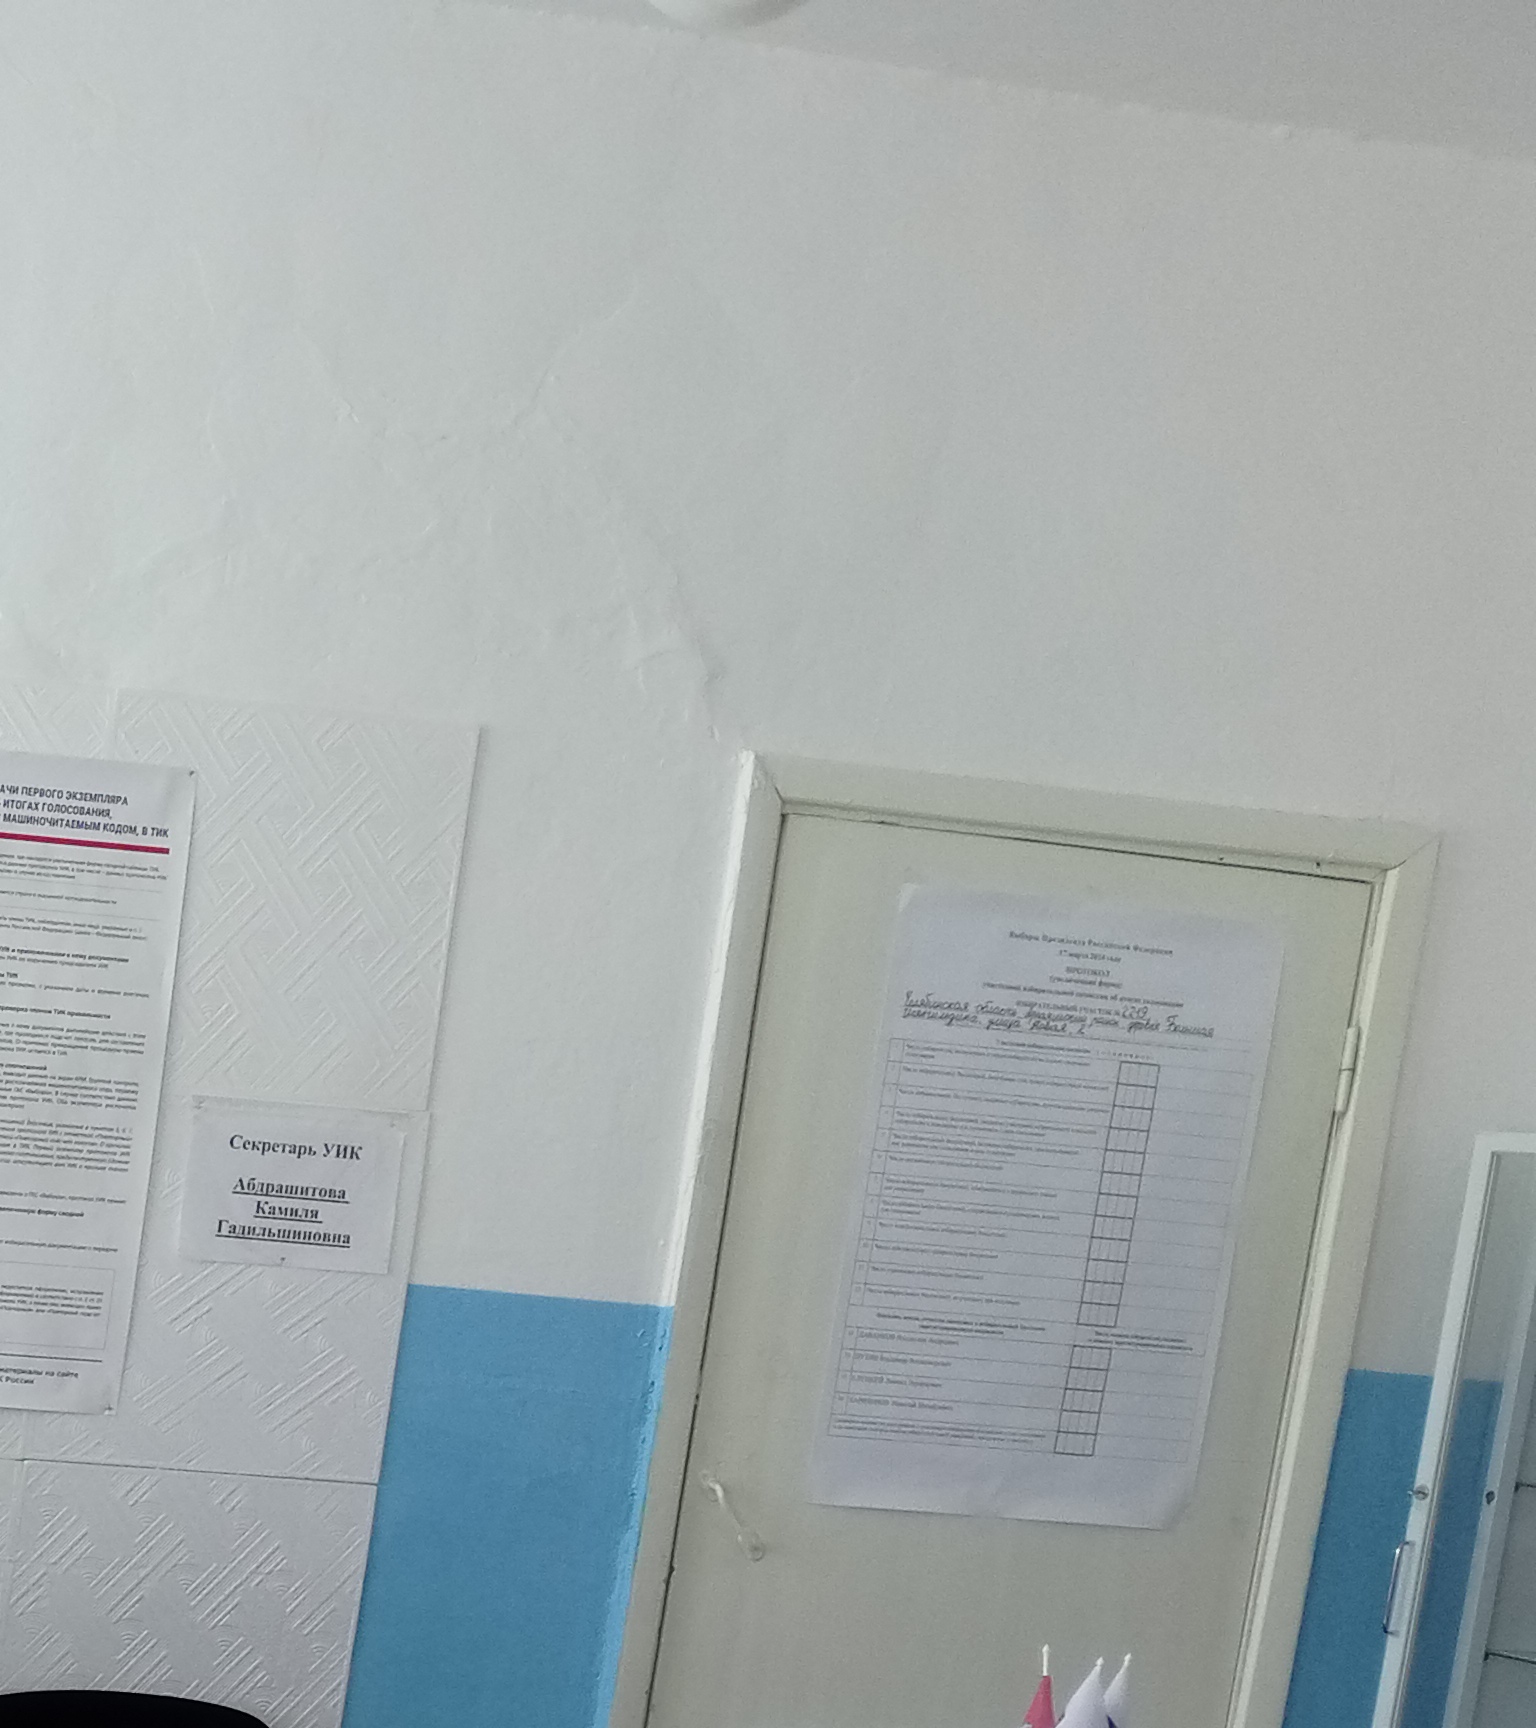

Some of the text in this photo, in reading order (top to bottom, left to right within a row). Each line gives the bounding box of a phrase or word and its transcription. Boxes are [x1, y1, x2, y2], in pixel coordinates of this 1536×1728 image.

[21, 785, 64, 800] ПЕРВОГО
[65, 790, 129, 806] ЭКЗЕМПЛЯРА
[2, 798, 40, 812] ИТОГАХ
[41, 802, 112, 820] ГОЛОСОВАНИЯ,
[3, 812, 101, 832] МАШИНОЧИТАЕМЫМ
[102, 823, 140, 837] КОДОМ,
[150, 827, 169, 838] ТИК
[229, 1134, 363, 1160] Секретарь УИК
[232, 1177, 347, 1201] Абдрашитова
[255, 1200, 320, 1220] Камиля
[216, 1218, 351, 1245] Гадильшиновна
